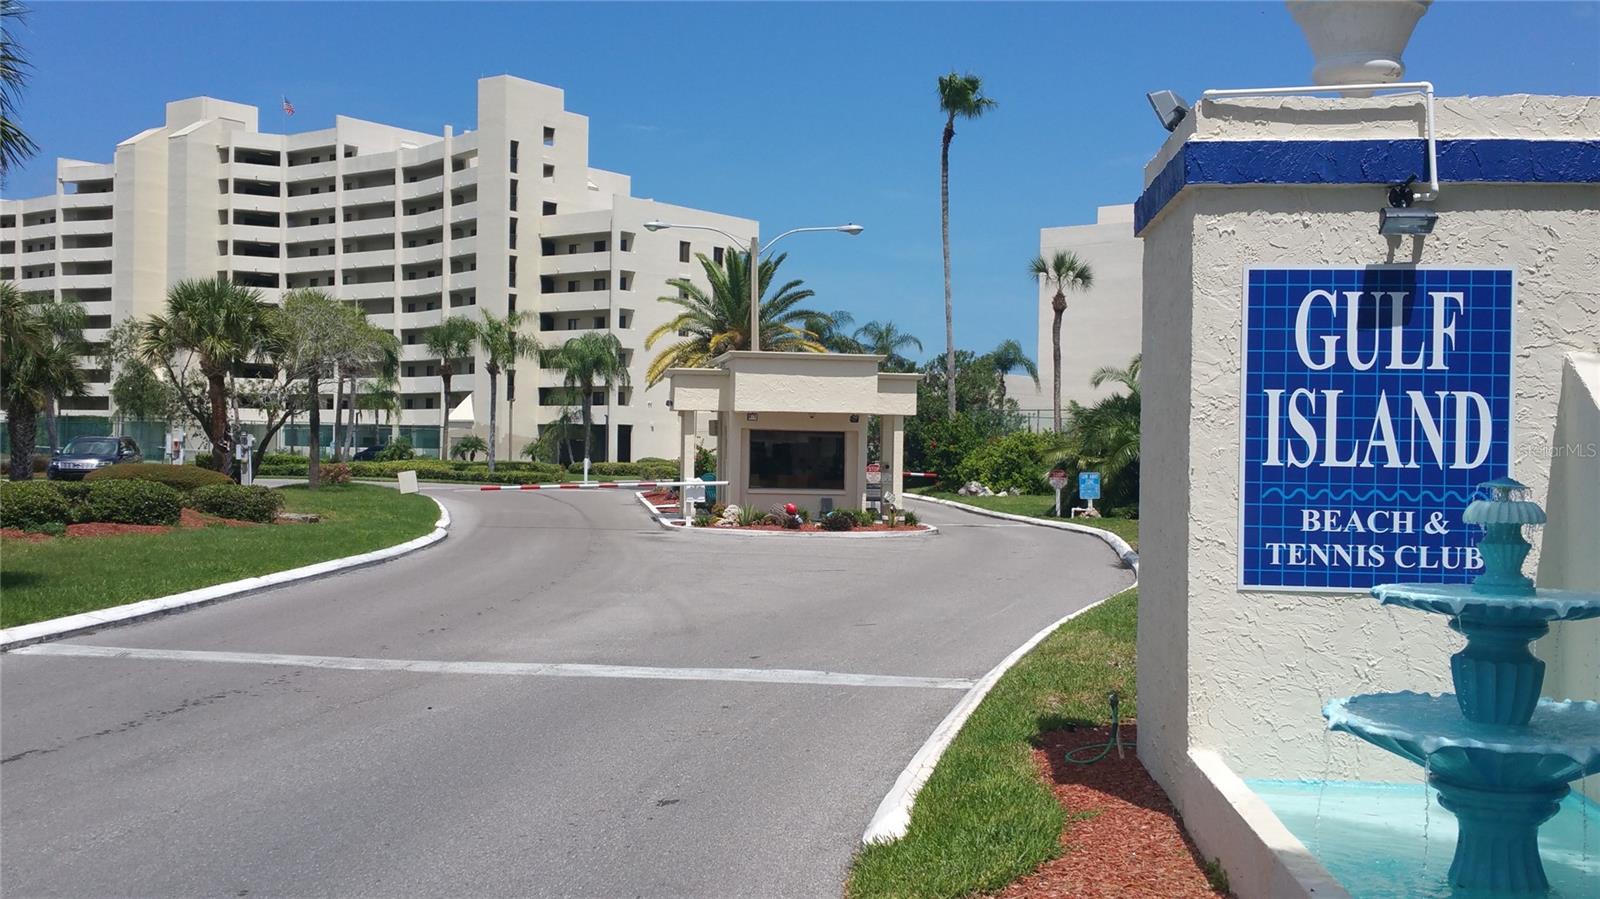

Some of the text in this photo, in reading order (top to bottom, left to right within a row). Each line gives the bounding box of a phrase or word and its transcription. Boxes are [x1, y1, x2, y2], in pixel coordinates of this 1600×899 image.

[1295, 289, 1464, 371] GULF
[1262, 387, 1493, 471] ISLAND
[1301, 509, 1450, 535] BEACH &
[1265, 542, 1484, 570] TENNIS CLUB
